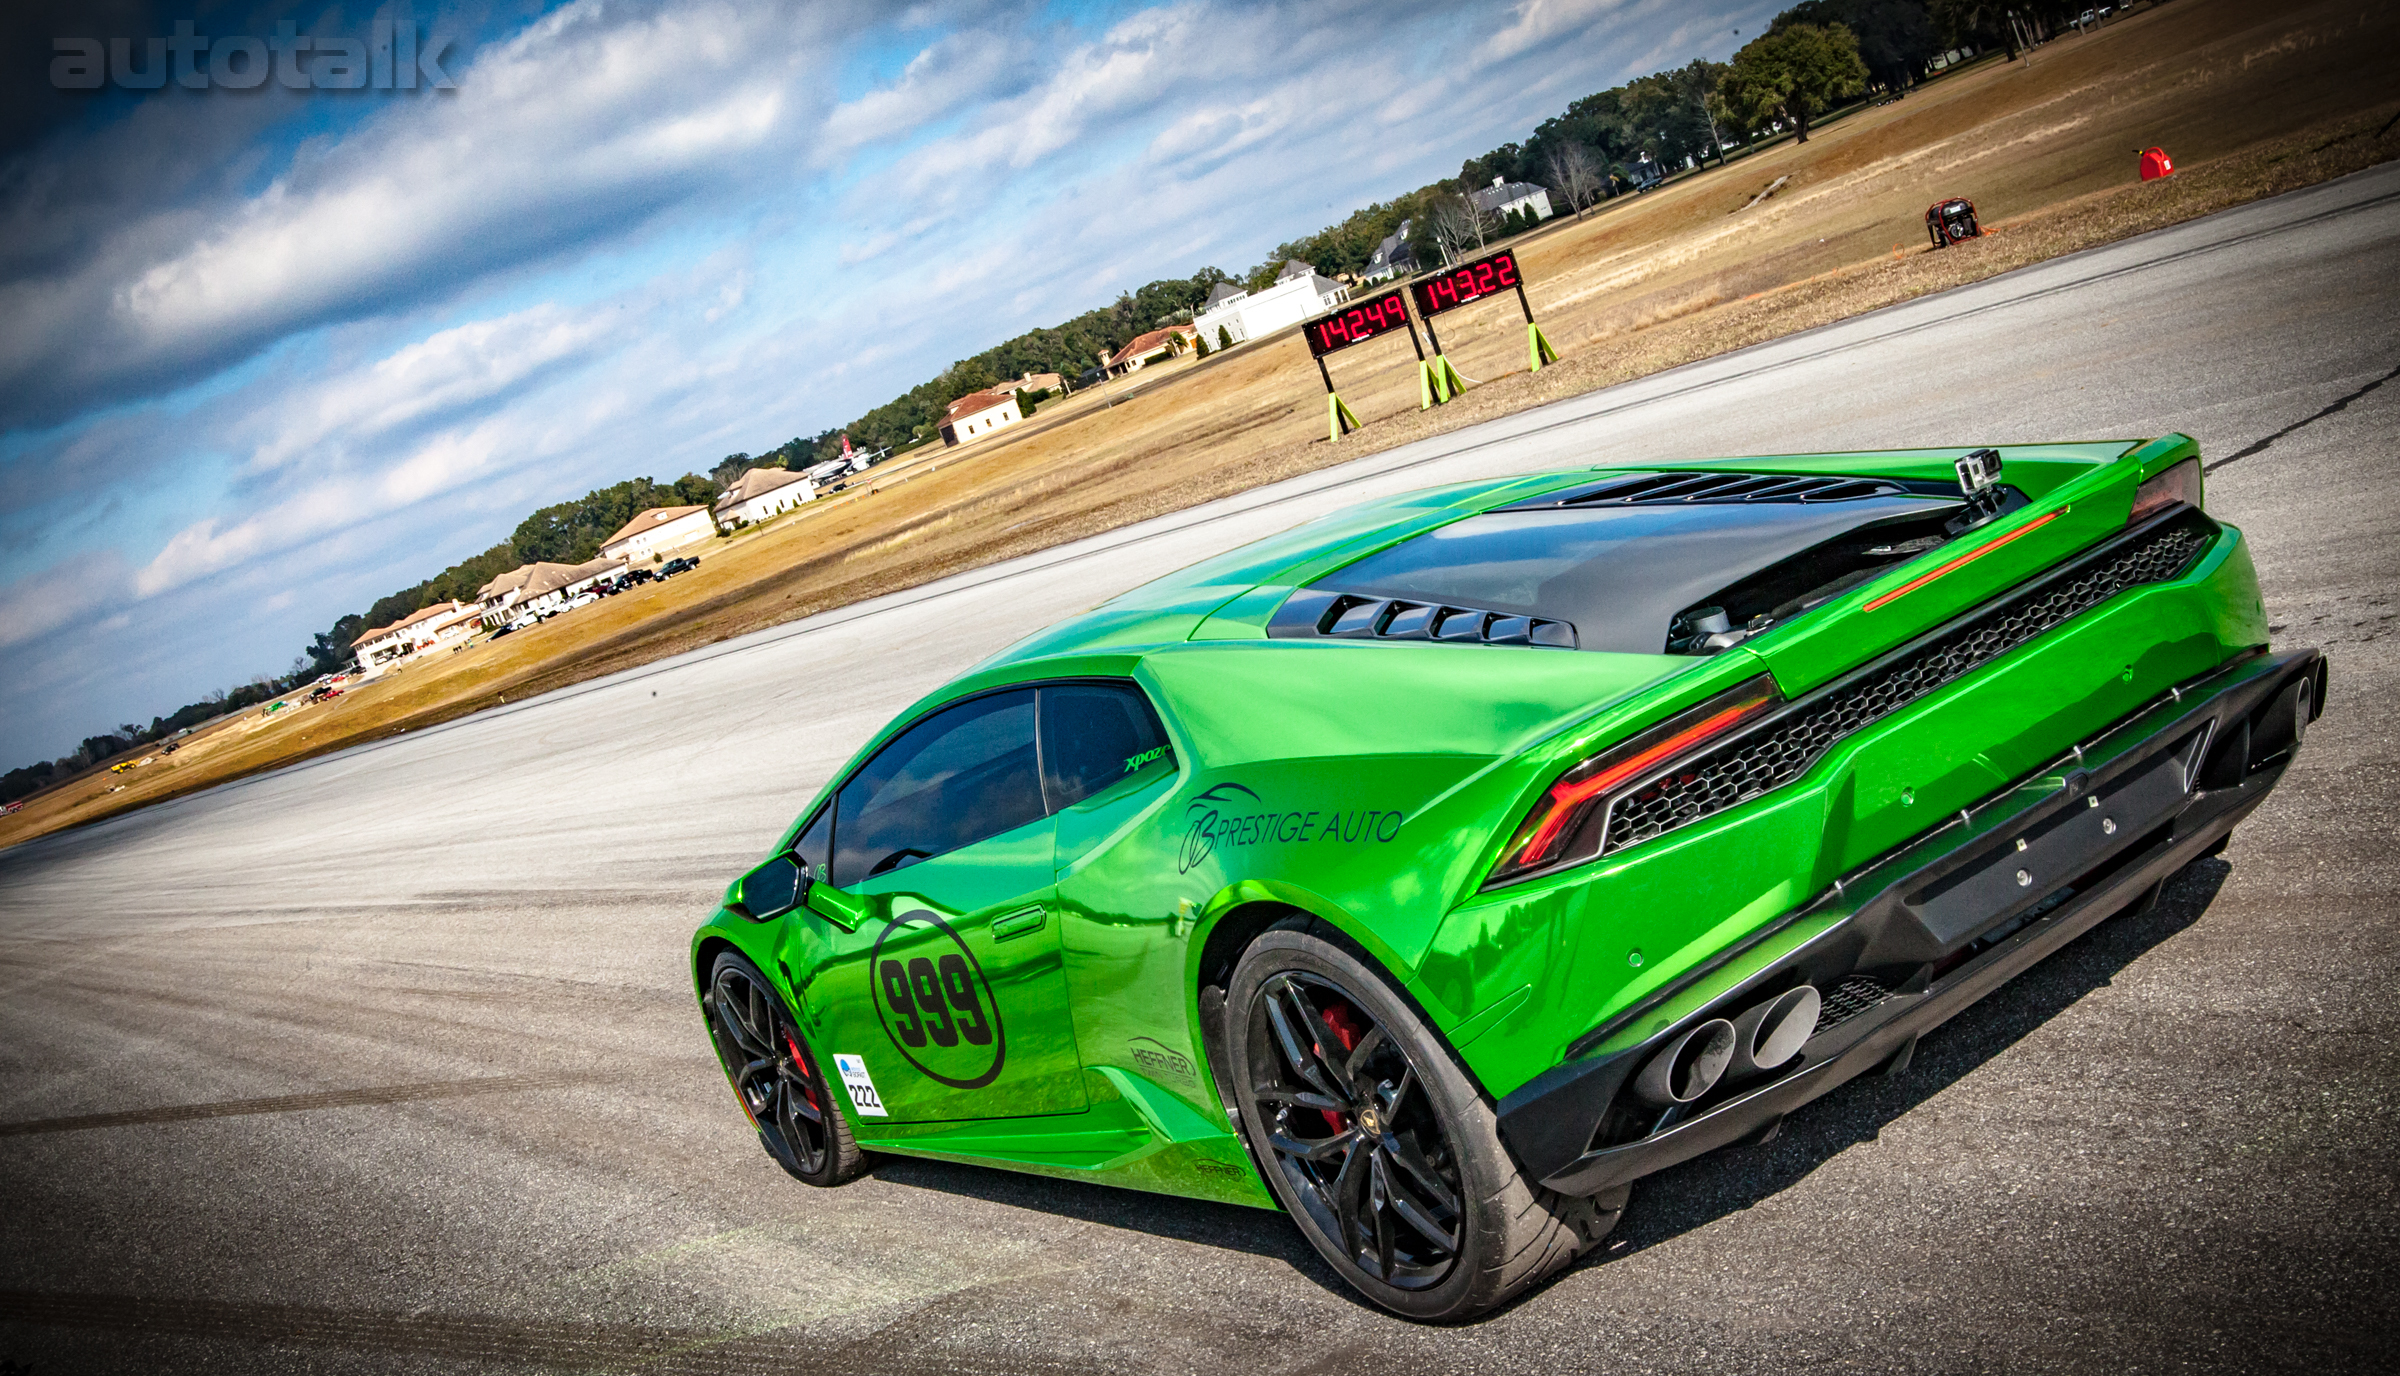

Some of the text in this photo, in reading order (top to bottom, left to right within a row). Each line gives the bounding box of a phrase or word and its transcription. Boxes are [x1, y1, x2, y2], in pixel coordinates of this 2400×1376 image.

[1215, 811, 1315, 849] PRESTIGE
[1319, 810, 1403, 843] AUTO
[880, 953, 993, 1048] 999
[1131, 1048, 1188, 1072] HEFFNER
[848, 1084, 881, 1108] 222
